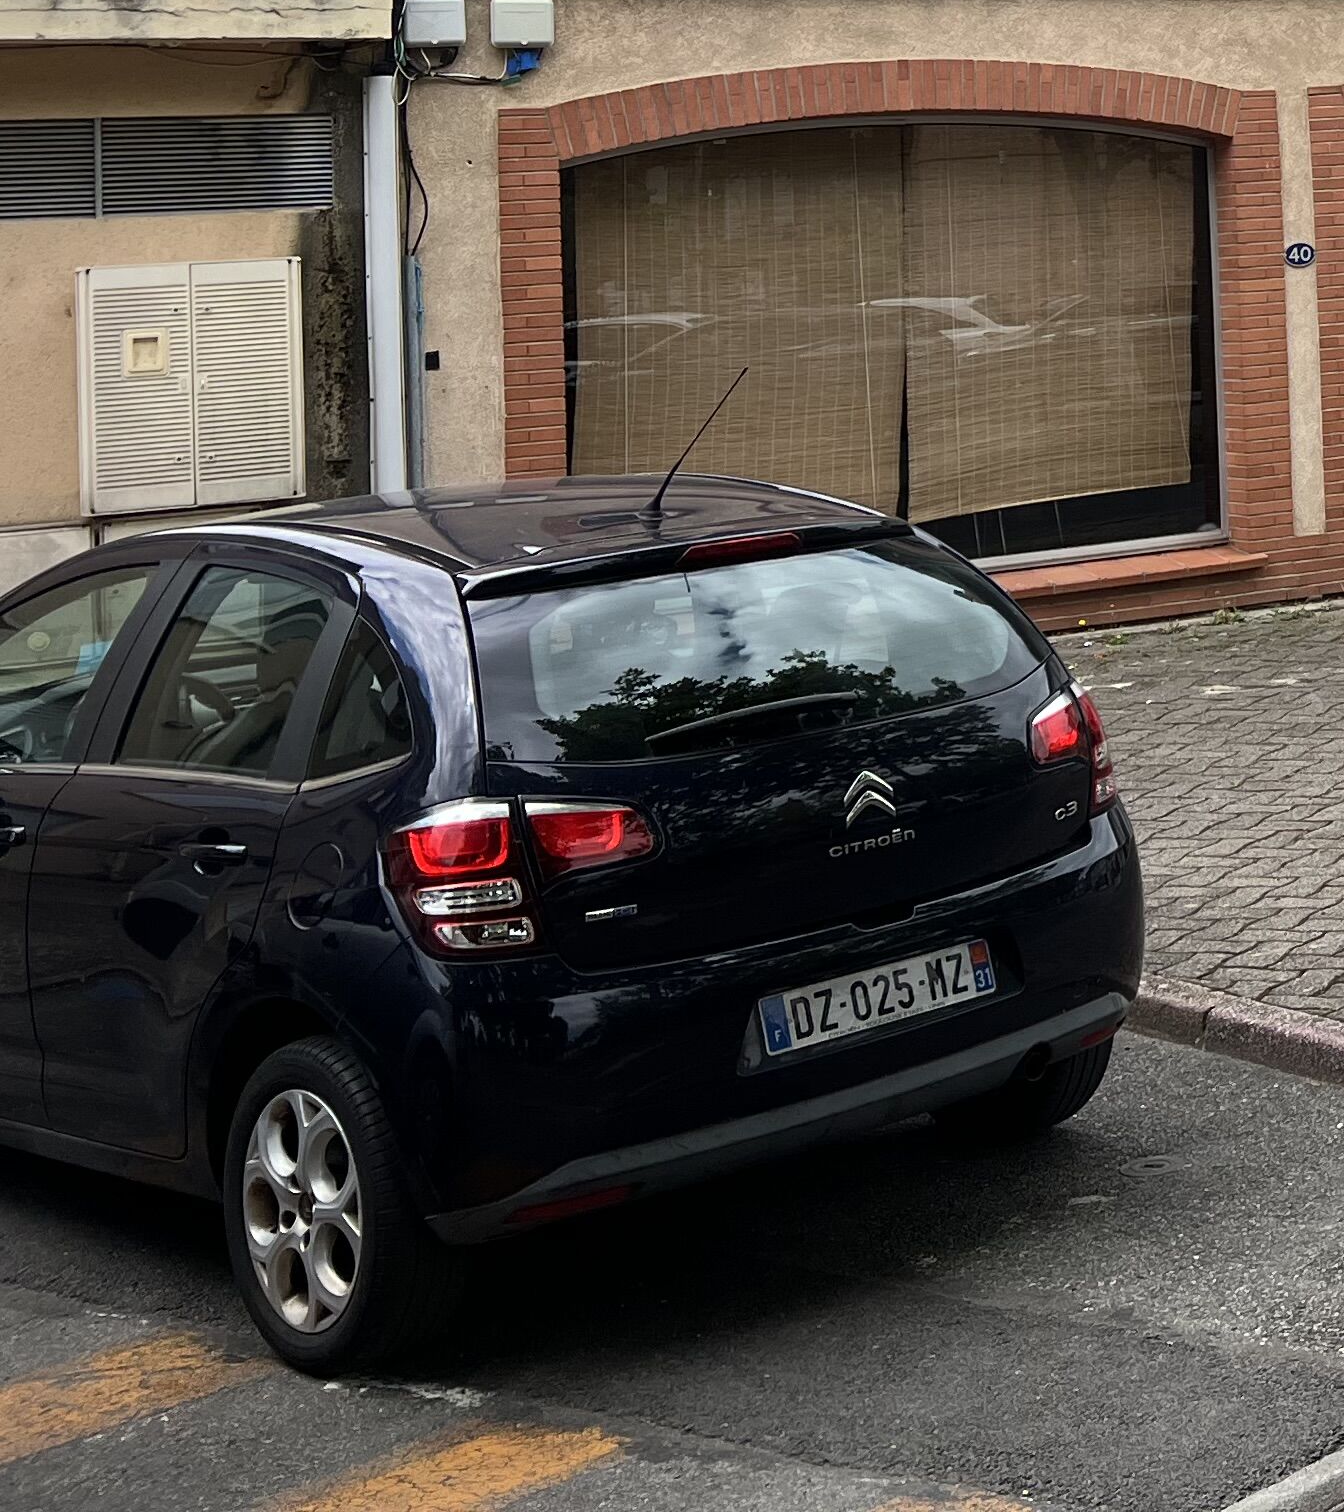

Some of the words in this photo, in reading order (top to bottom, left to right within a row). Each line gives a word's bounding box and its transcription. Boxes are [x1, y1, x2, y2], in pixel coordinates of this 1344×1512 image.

[1288, 246, 1312, 262] 40
[1054, 800, 1078, 821] C3
[975, 967, 993, 989] 31
[790, 952, 969, 1041] DZ-025-MZ
[774, 1029, 783, 1044] F
